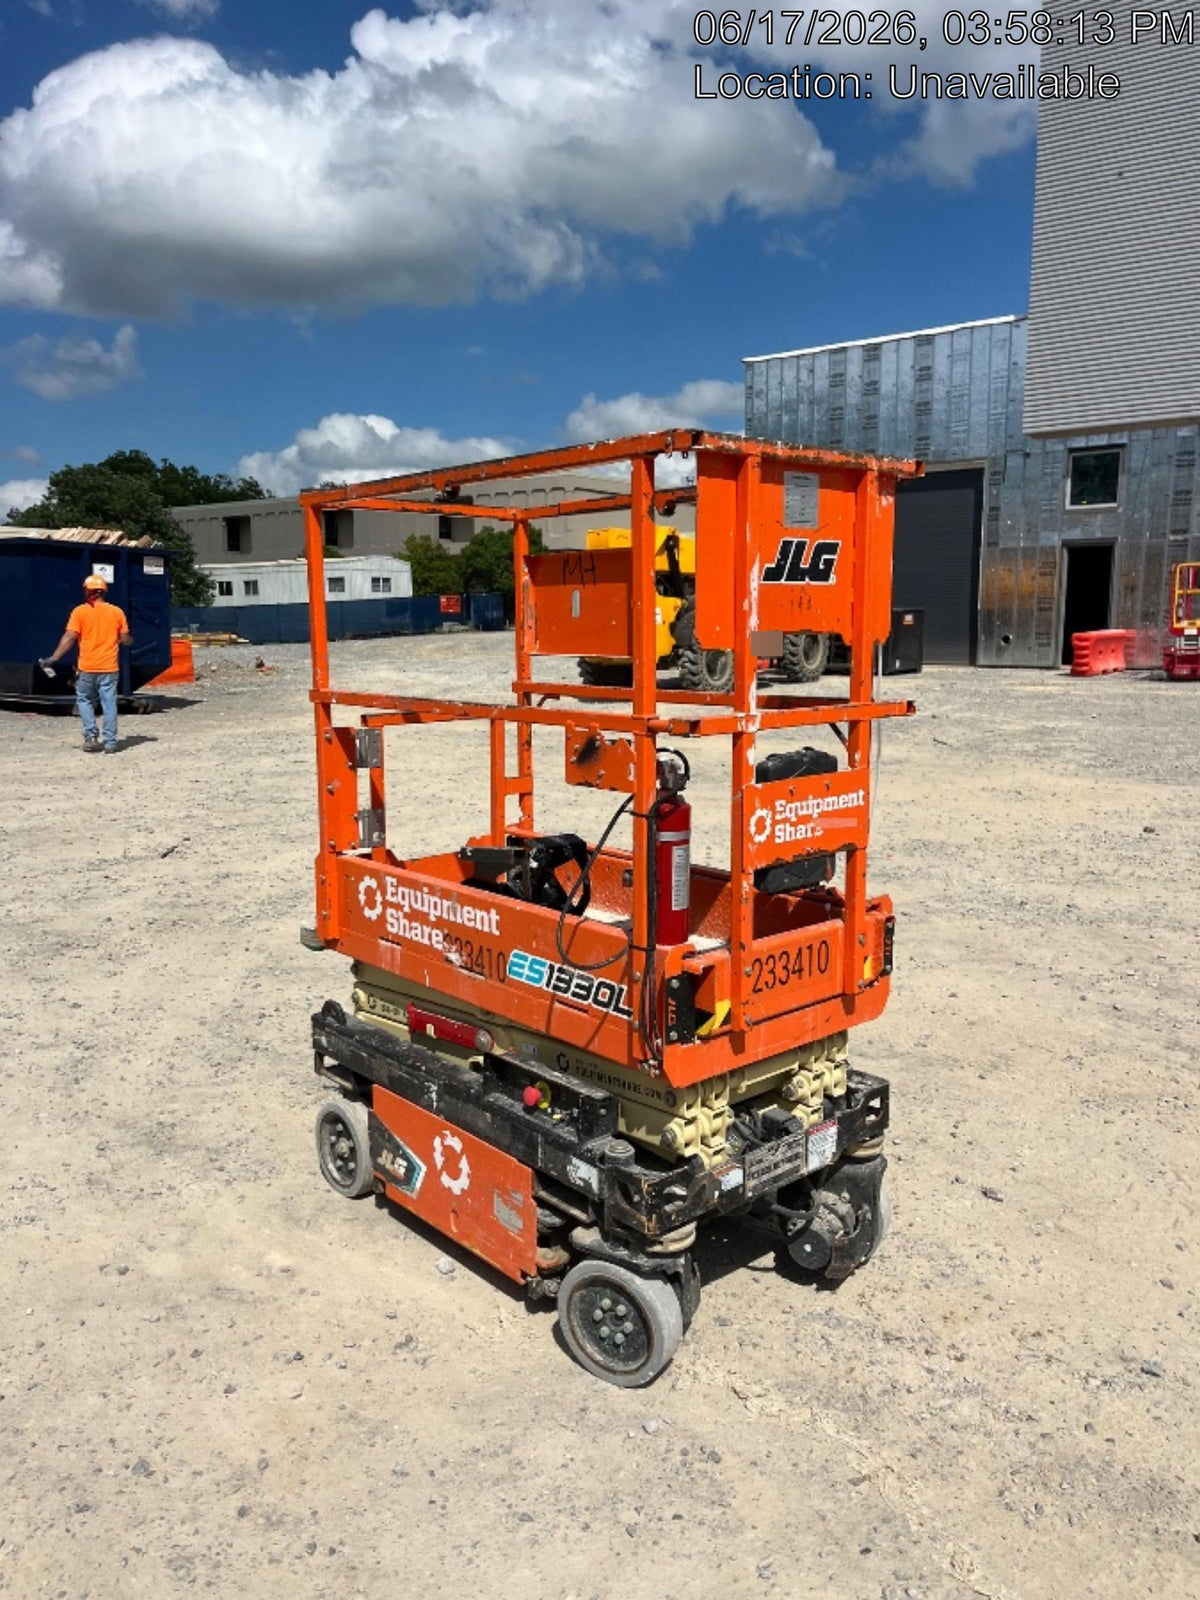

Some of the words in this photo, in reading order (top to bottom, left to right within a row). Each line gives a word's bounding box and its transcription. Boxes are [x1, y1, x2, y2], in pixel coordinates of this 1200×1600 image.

[761, 538, 842, 584] JLG
[774, 788, 865, 822] Equipment
[385, 876, 501, 936] Equipment
[386, 907, 444, 953] Share
[507, 949, 634, 1020] ES1330L
[751, 940, 830, 993] 233410
[376, 1149, 408, 1179] JLG
